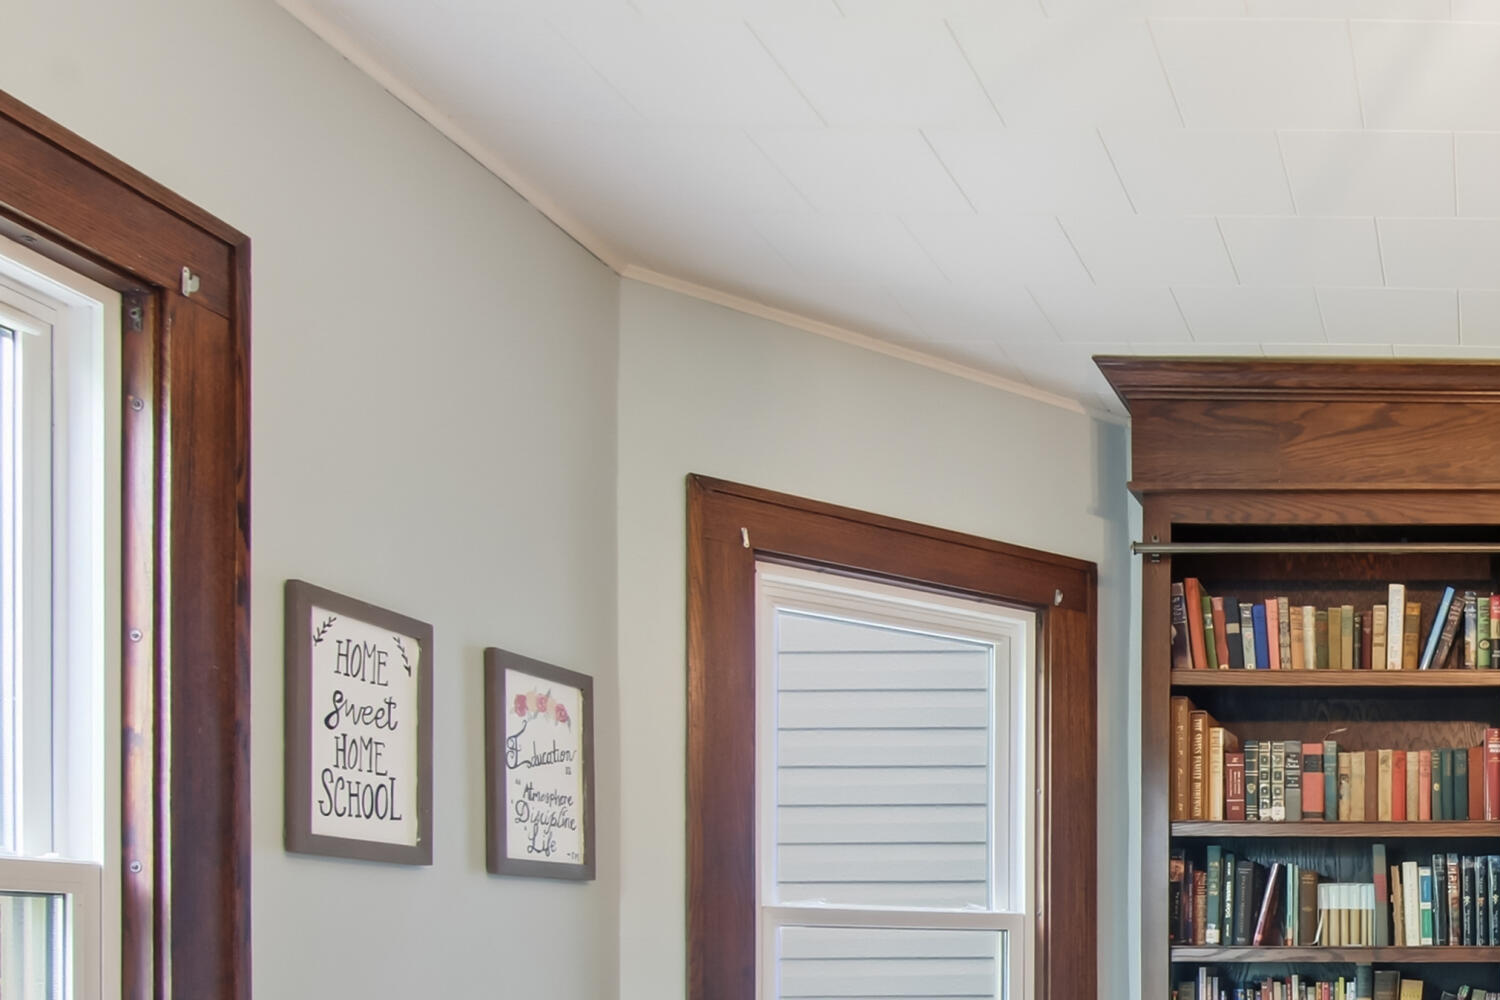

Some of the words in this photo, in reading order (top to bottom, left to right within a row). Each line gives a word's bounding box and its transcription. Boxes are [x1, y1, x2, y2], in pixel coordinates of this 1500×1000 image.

[333, 638, 389, 687] HOME
[332, 733, 388, 777] HOME
[505, 719, 577, 770] Education
[317, 767, 403, 822] SCHOOL
[522, 781, 574, 808] Atmosphere
[514, 799, 577, 835] Discipline
[526, 823, 557, 858] Life
